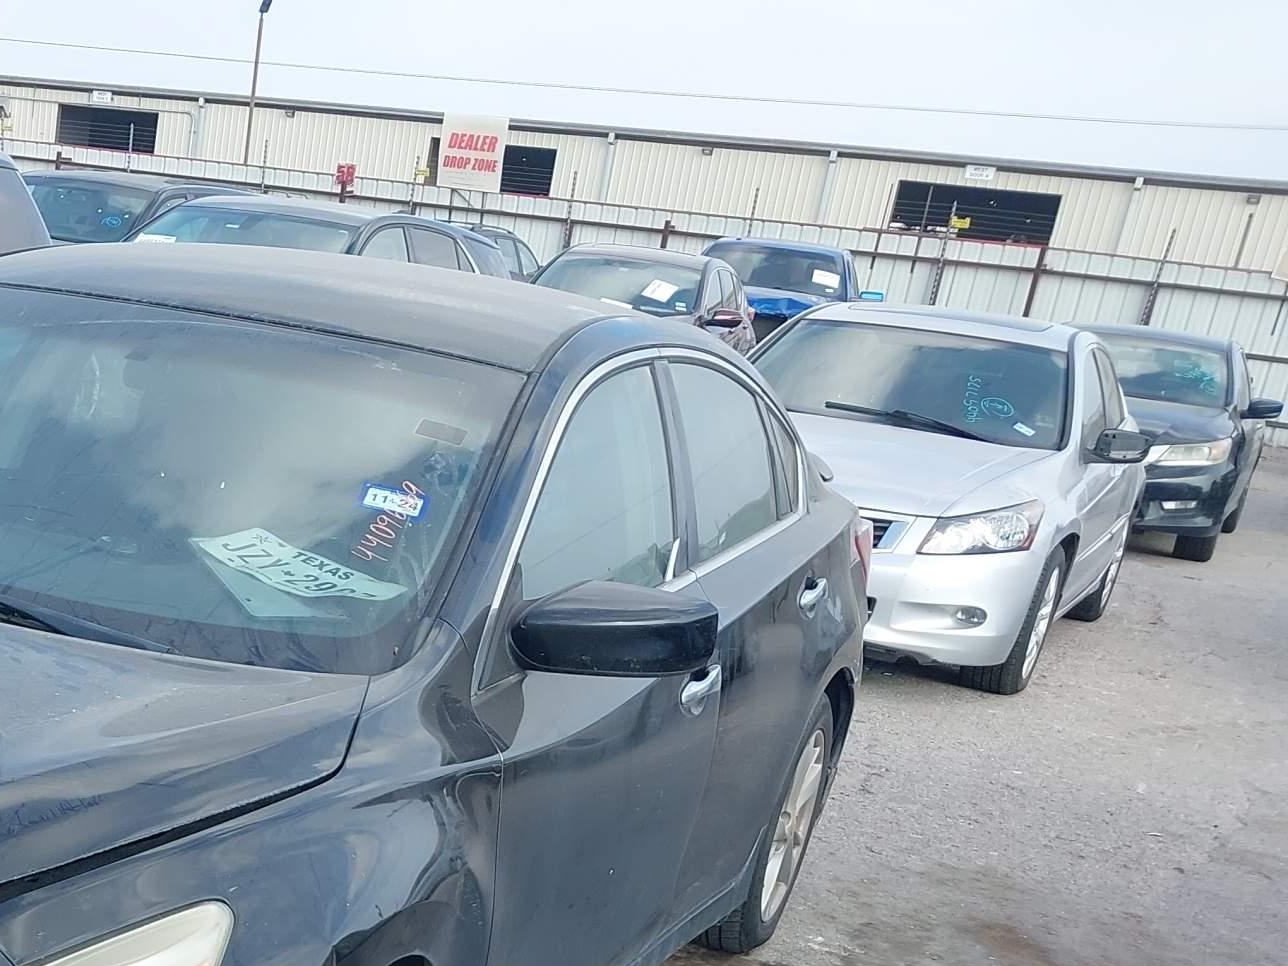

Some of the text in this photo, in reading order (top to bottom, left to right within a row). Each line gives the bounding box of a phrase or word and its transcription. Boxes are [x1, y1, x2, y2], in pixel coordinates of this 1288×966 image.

[448, 132, 498, 152] DEALER
[443, 155, 499, 173] DROP ZONE
[292, 551, 355, 581] TEXAS
